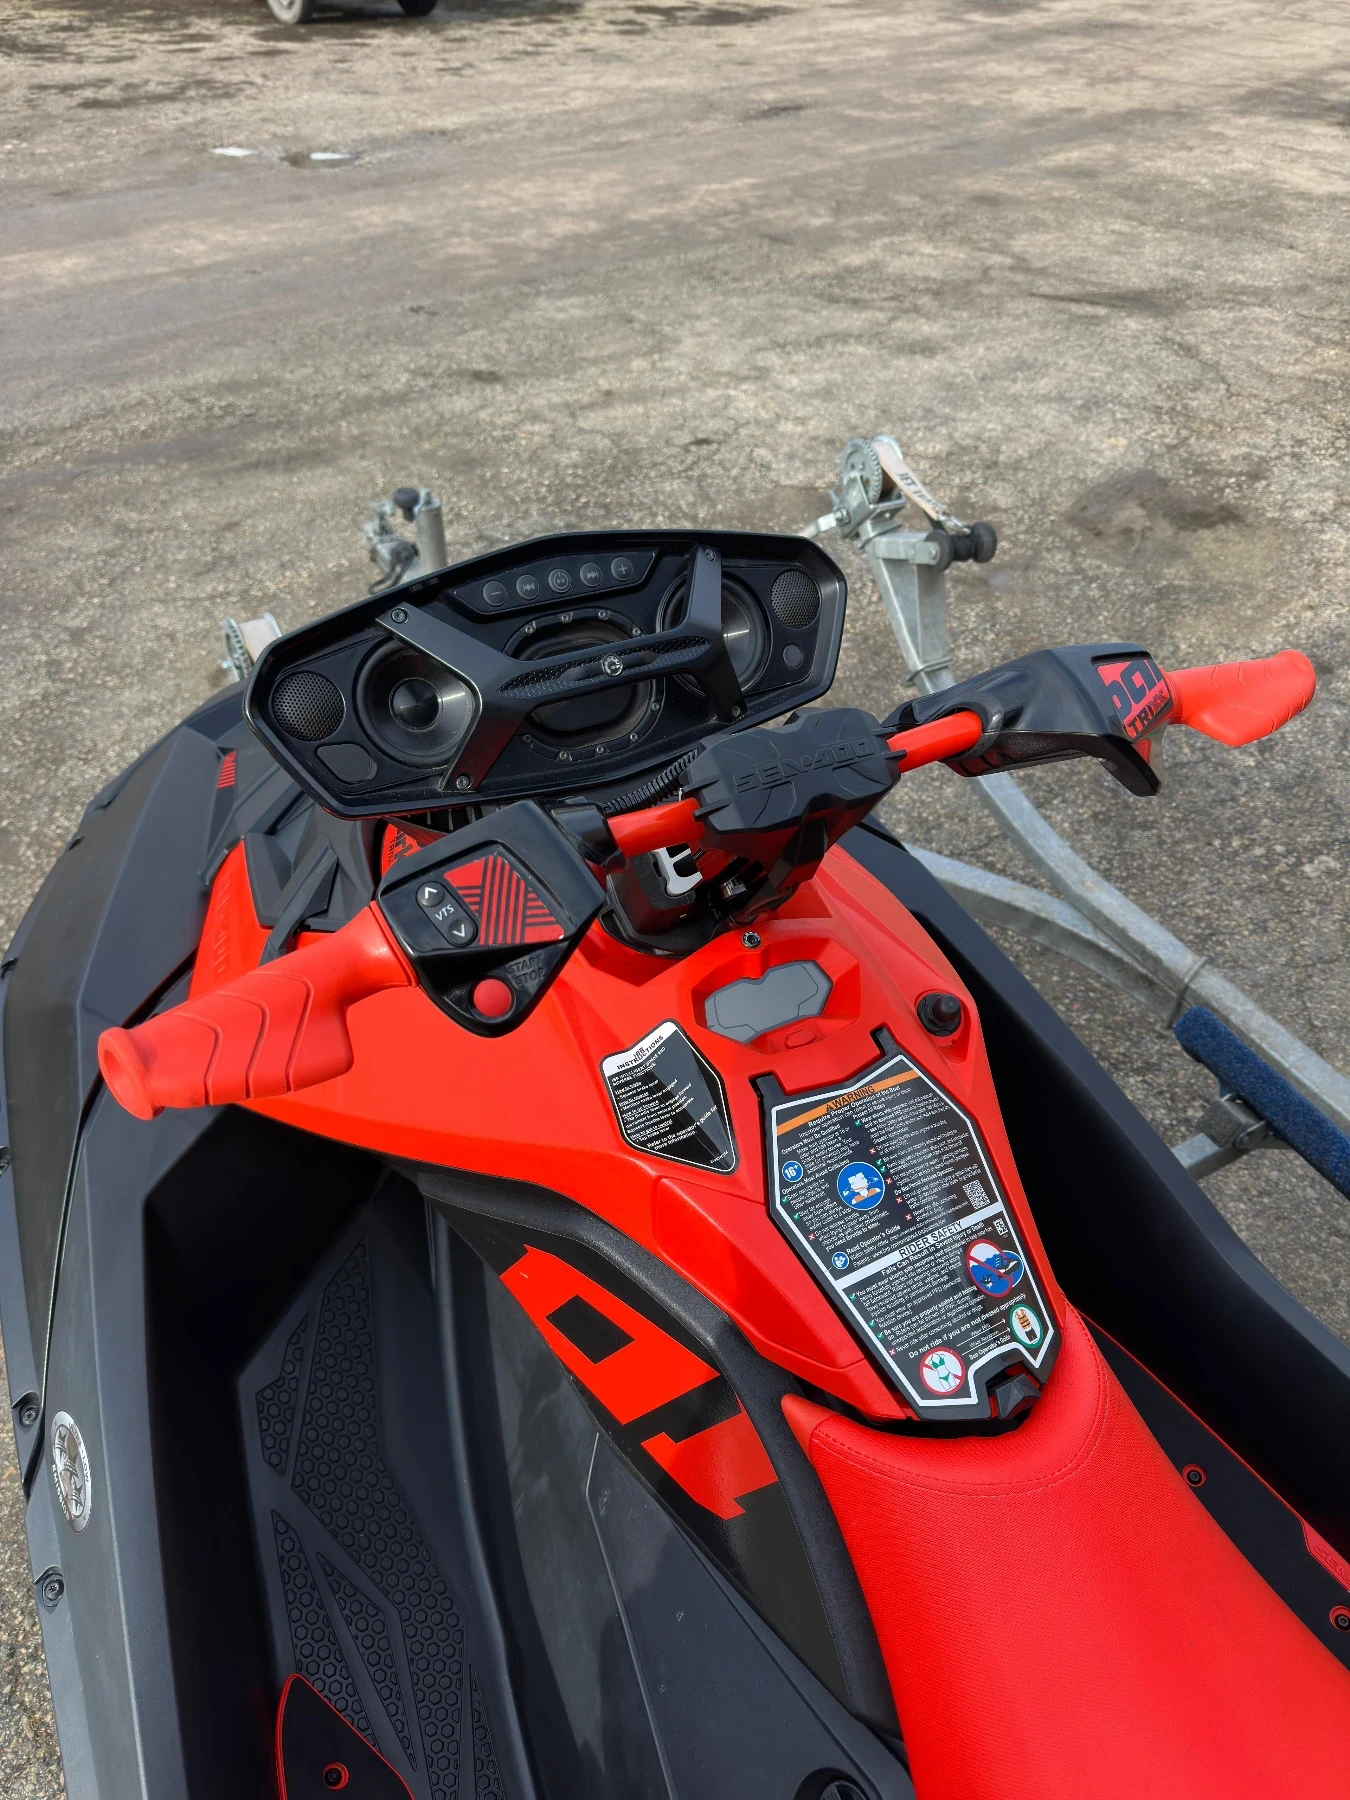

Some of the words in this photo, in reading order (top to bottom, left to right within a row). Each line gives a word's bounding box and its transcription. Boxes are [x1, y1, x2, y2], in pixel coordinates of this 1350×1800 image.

[435, 904, 454, 921] VTS
[507, 954, 544, 975] START
[515, 967, 545, 985] STOP
[616, 1035, 664, 1070] INSTRUCTIONS
[807, 1112, 831, 1128] Require
[830, 1104, 850, 1117] Proper
[850, 1092, 876, 1109] Operation
[888, 1084, 900, 1093] Boat
[831, 1084, 874, 1109] WARNING
[845, 1243, 860, 1254] Read
[858, 1231, 886, 1248] Operator's
[884, 1223, 900, 1235] Guide
[898, 1237, 931, 1258] RIDER
[929, 1220, 964, 1243] SAFETY
[880, 1264, 897, 1276] Falls
[896, 1258, 910, 1269] Can
[908, 1248, 929, 1262] Result
[908, 1349, 919, 1359] Do
[918, 1343, 930, 1353] not
[929, 1336, 943, 1348] ride
[941, 1333, 948, 1341] if
[947, 1328, 960, 1340] you
[958, 1322, 971, 1332] are
[969, 1316, 981, 1326] not
[980, 1306, 1000, 1320] dressed
[999, 1334, 1011, 1343] Guide
